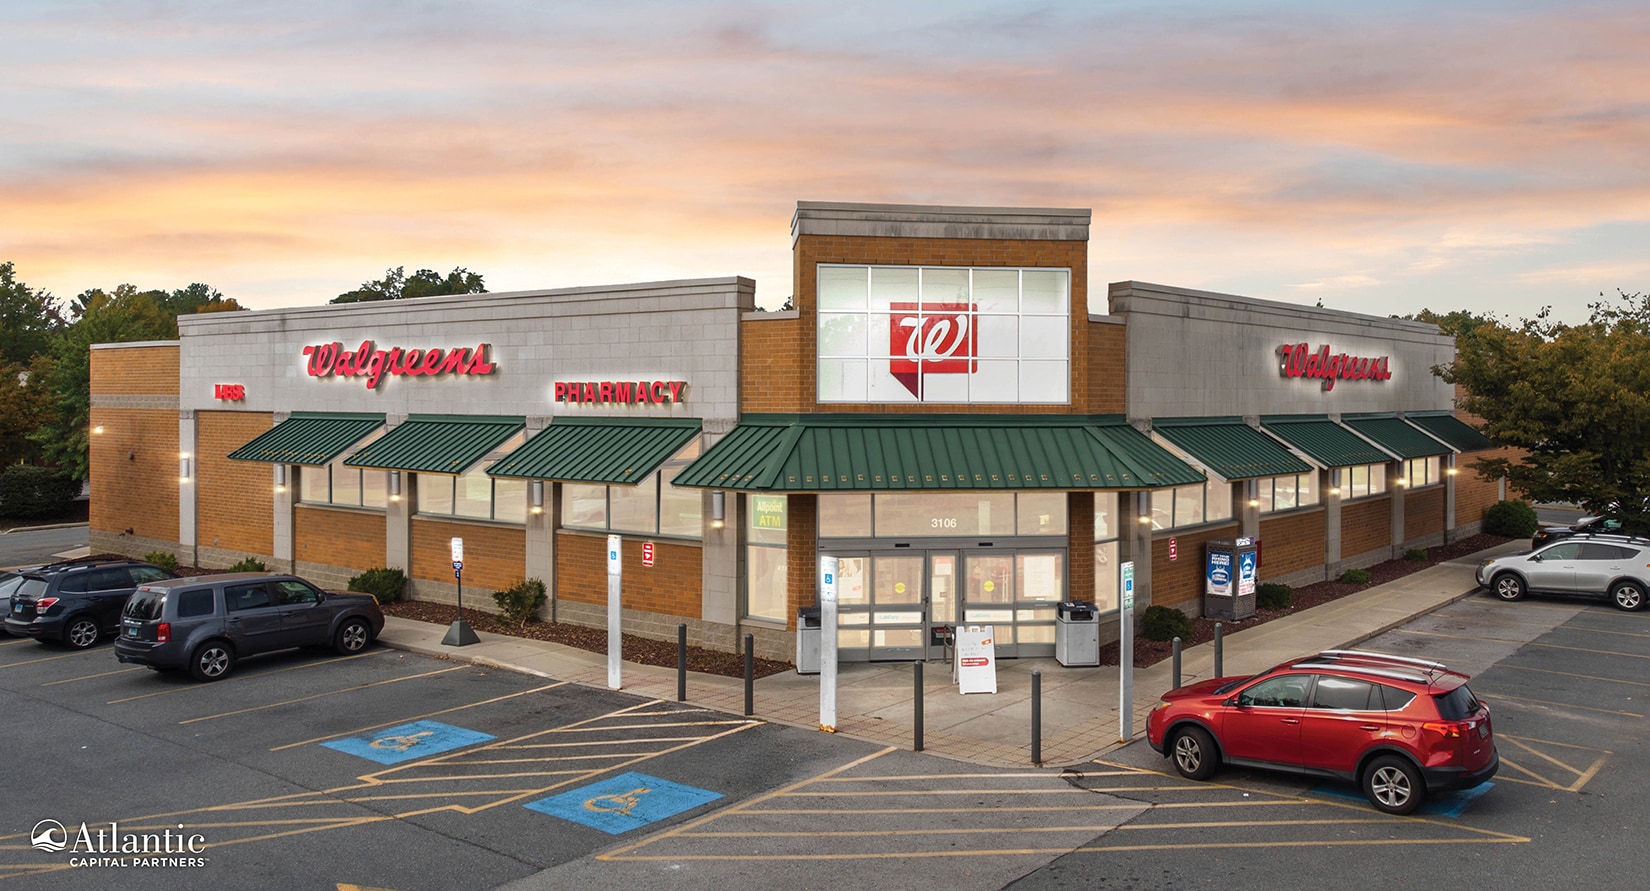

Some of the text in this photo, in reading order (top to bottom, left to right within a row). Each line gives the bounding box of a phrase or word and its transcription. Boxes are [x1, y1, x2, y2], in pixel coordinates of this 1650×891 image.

[303, 340, 495, 389] Walgreens
[1277, 342, 1393, 392] Walgreens
[554, 381, 686, 403] PHARMACY
[757, 500, 783, 513] Allpoint
[759, 515, 781, 527] ATM
[931, 518, 957, 528] 3106
